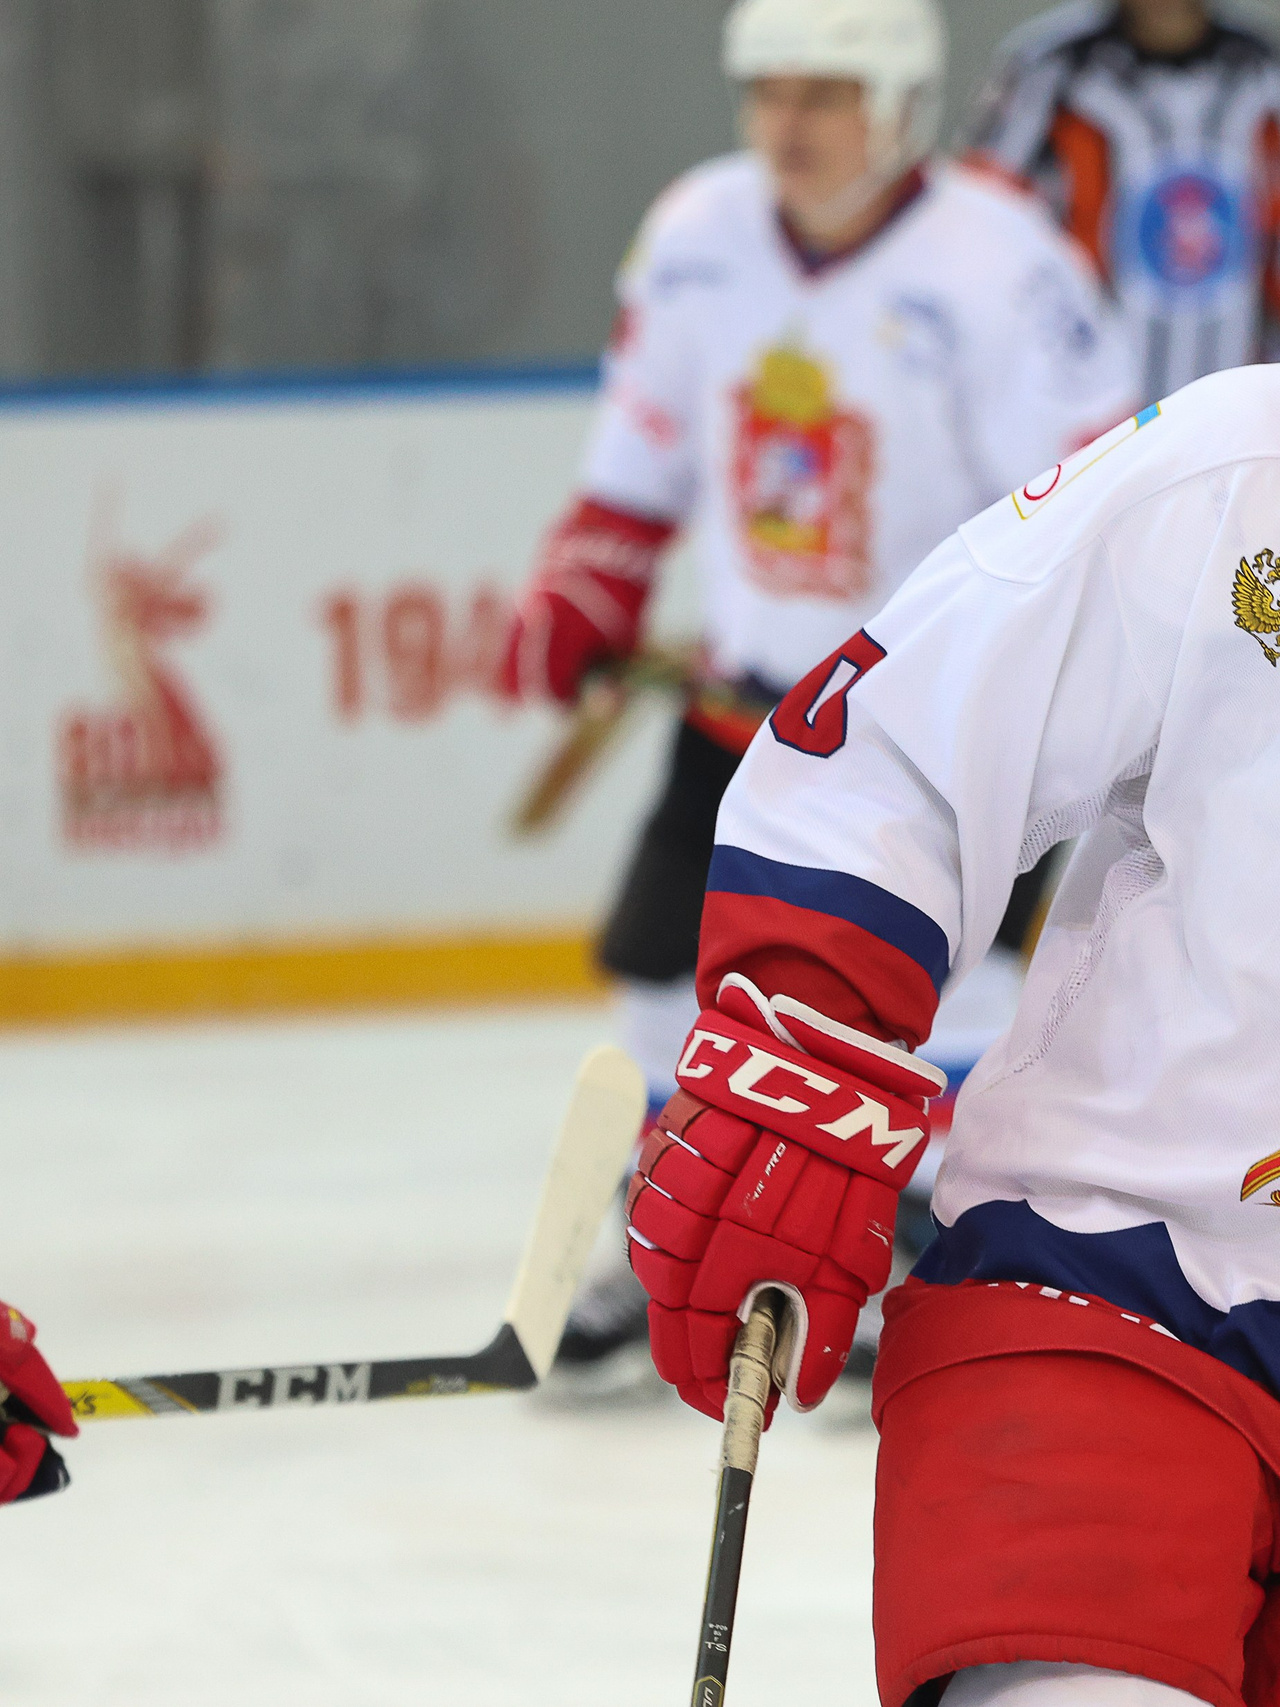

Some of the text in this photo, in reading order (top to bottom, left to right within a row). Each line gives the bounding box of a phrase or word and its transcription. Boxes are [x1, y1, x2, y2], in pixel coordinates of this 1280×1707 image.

[677, 1029, 925, 1169] CCM
[764, 1141, 787, 1176] PRO
[217, 1363, 372, 1410] CCM
